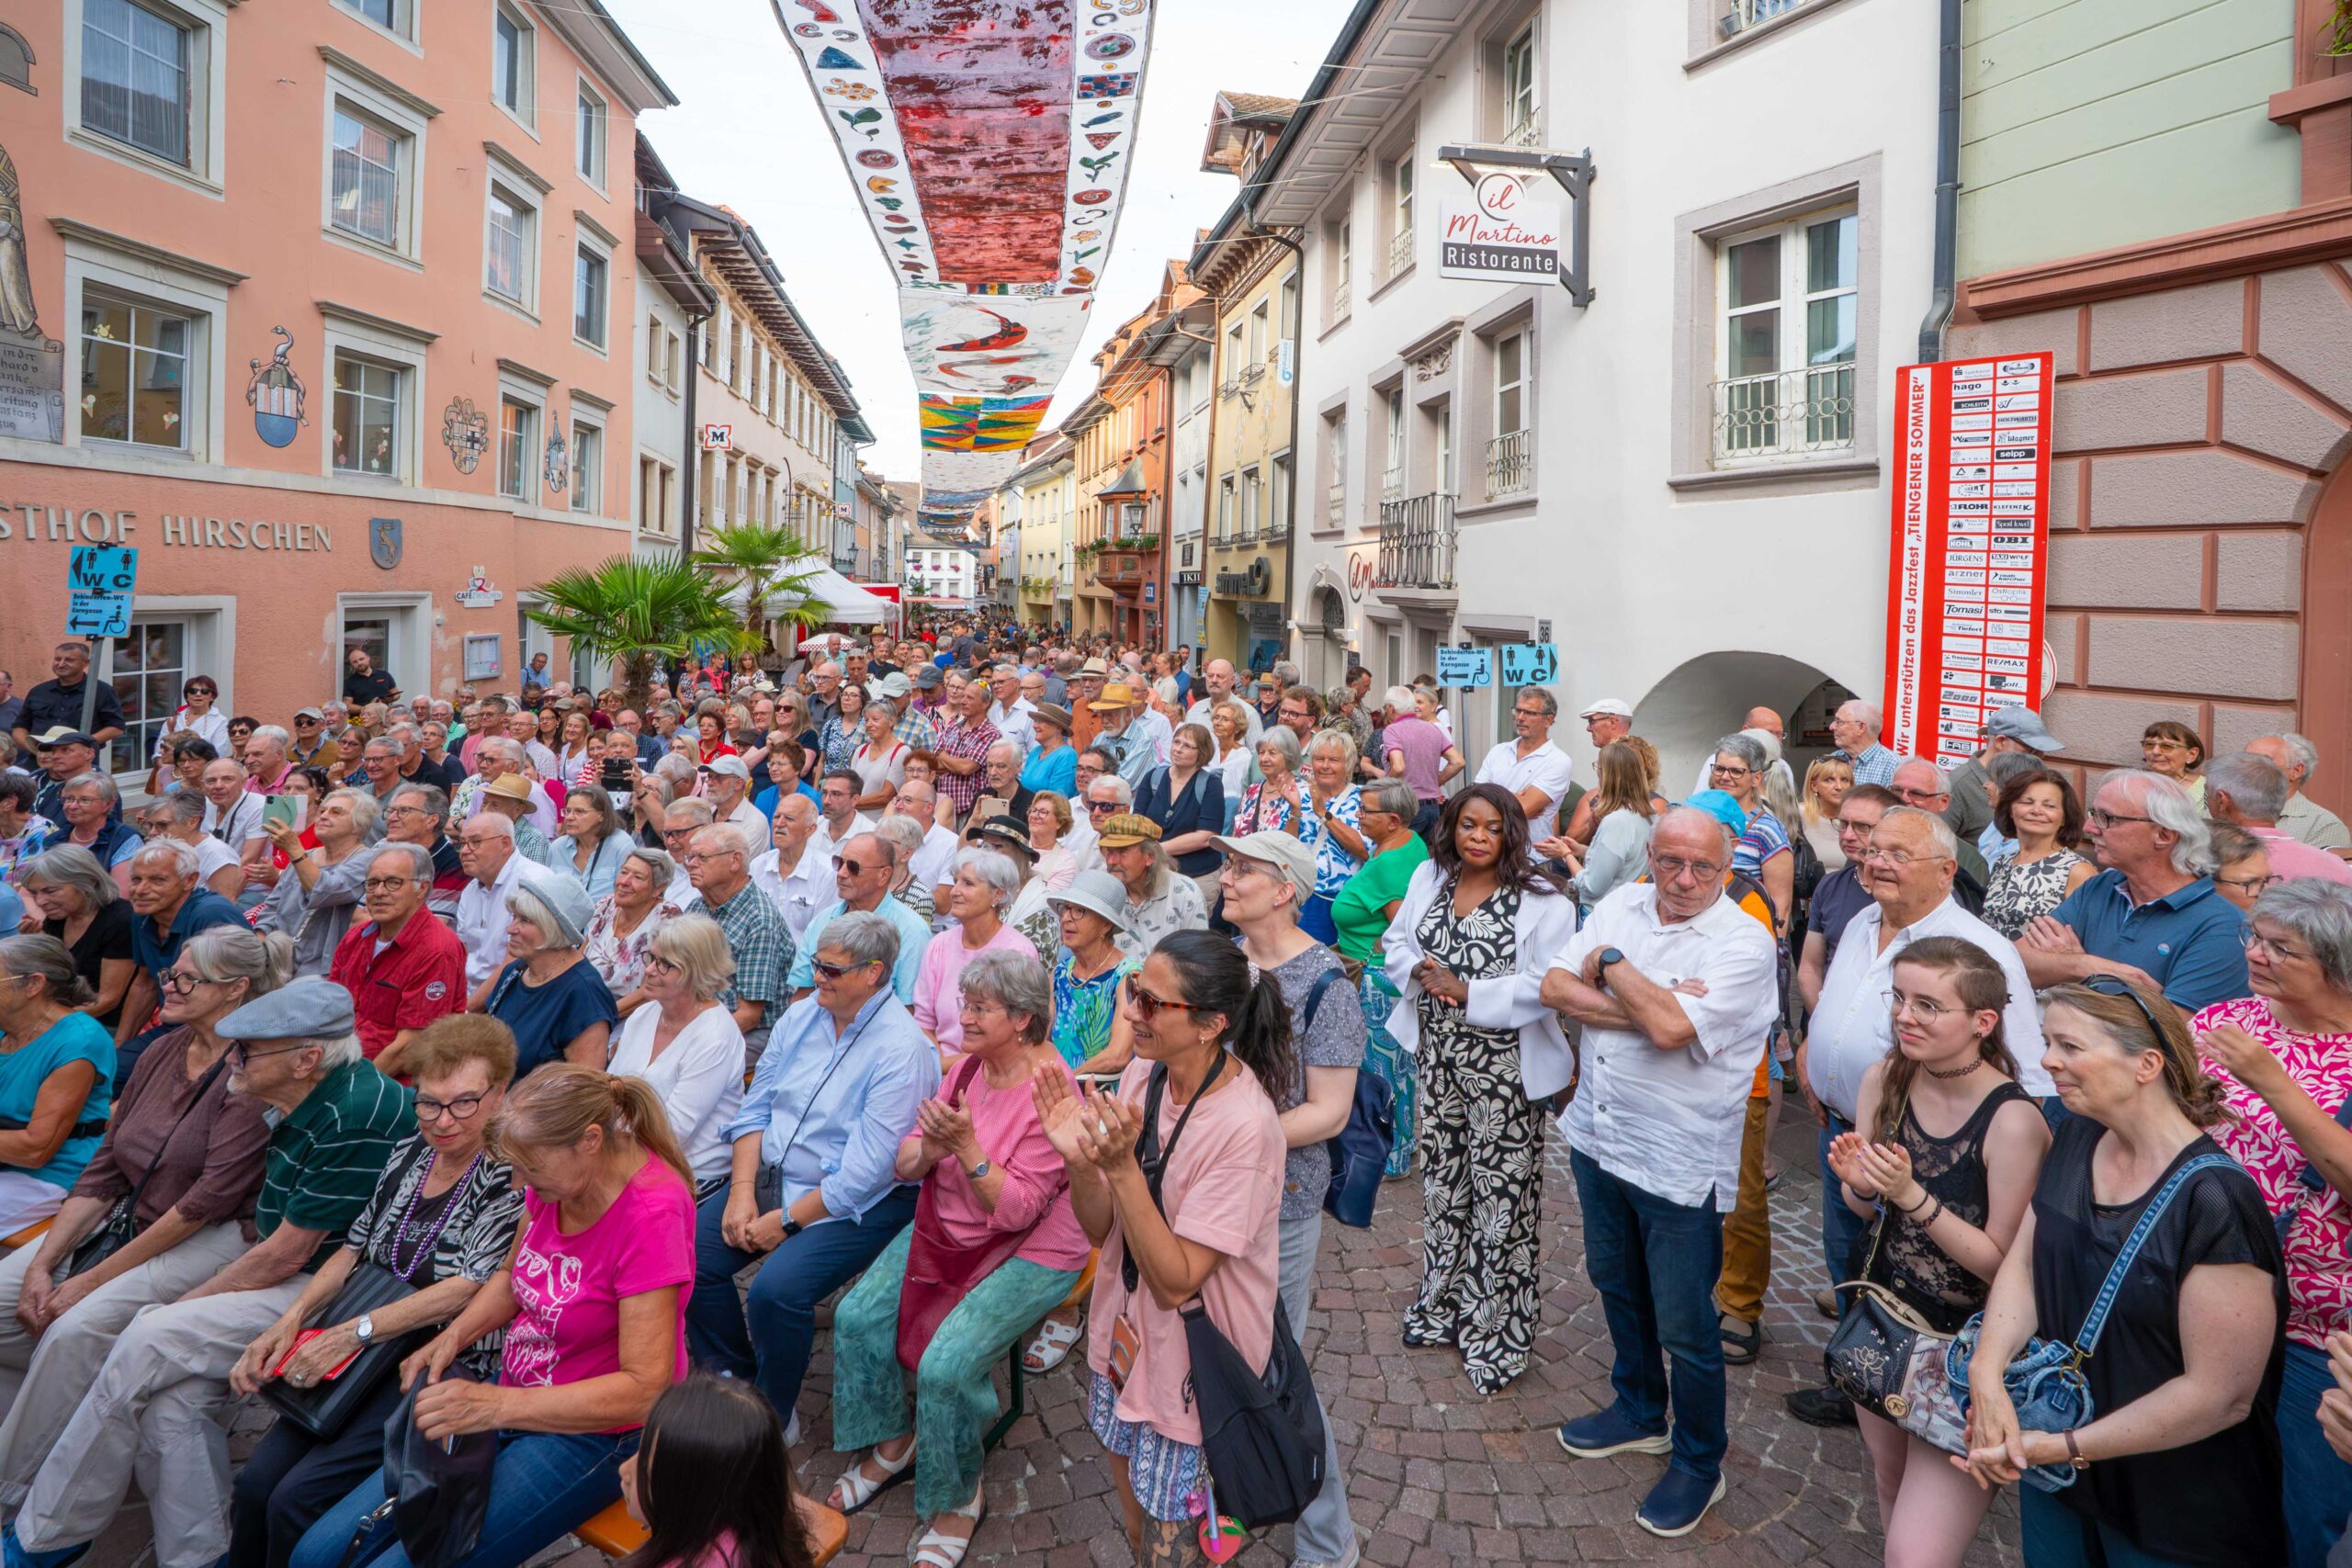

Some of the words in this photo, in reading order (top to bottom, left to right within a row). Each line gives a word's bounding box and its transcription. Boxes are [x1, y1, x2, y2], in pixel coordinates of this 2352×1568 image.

[1487, 184, 1515, 209] il
[1447, 214, 1556, 246] Martino
[1447, 247, 1554, 271] Ristorante
[711, 432, 725, 442] M
[163, 514, 332, 552] HIRSCHEN
[1949, 554, 1984, 562] JÜRGENS
[1905, 547, 1919, 604] Jazzfest
[1947, 587, 1983, 596] Simmler
[1903, 609, 1917, 634] das
[1946, 604, 1984, 615] Tomasi
[1540, 626, 1550, 643] 36
[1987, 658, 2025, 667] RE/MAX
[1901, 638, 1915, 728] unterstützen
[1896, 732, 1909, 756] Wir
